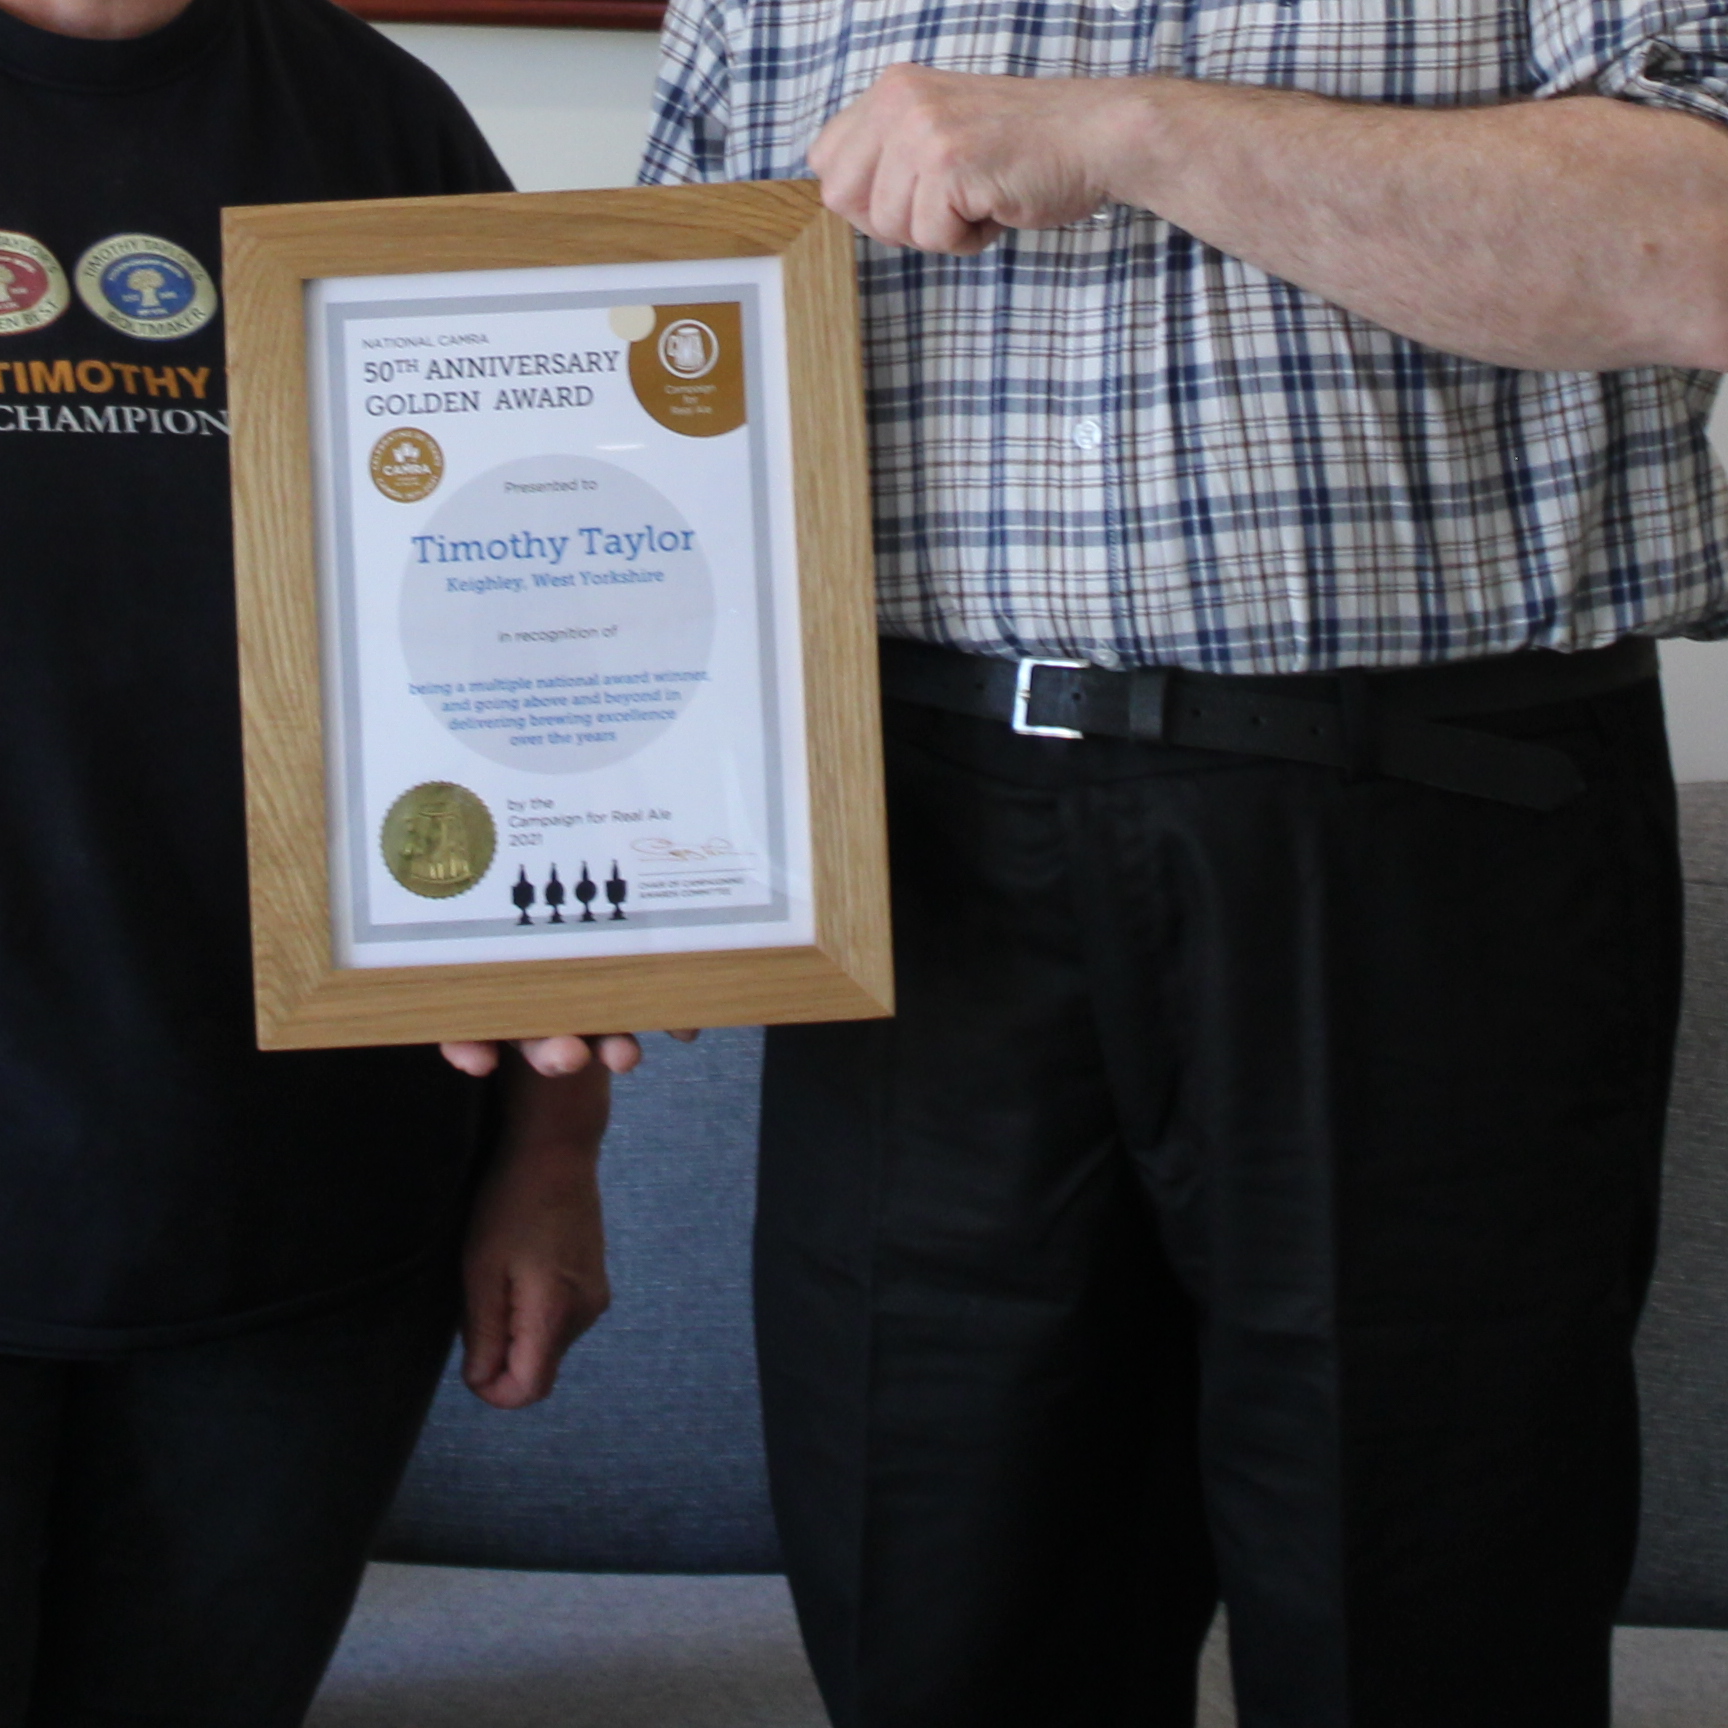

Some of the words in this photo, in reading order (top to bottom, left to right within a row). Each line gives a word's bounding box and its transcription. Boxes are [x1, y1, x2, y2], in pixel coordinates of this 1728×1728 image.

[84, 241, 136, 277] TIMOTHY
[362, 336, 434, 349] NATIONAL
[438, 333, 489, 346] CAMRA
[364, 358, 419, 384] 50TH
[424, 350, 620, 381] ANNIVERSARY
[365, 390, 480, 416] GOLDEN
[493, 385, 594, 411] AWARD
[504, 480, 577, 494] Presented
[582, 480, 597, 491] to
[411, 531, 569, 564] Timothy
[578, 524, 695, 560] Taylor
[532, 573, 576, 588] West
[579, 569, 664, 586] Yorkshire
[498, 632, 512, 642] in
[514, 628, 598, 643] recognition
[602, 625, 618, 638] of
[409, 683, 452, 696] being
[456, 684, 465, 693] a
[469, 678, 532, 693] multiple
[536, 674, 600, 689] national
[603, 672, 650, 685] award
[442, 700, 470, 712] and
[474, 699, 519, 713] going
[524, 696, 568, 708] above
[572, 694, 601, 705] and
[603, 691, 662, 705] beyond
[664, 690, 682, 701] in
[449, 717, 525, 730] delivering
[529, 714, 592, 726] brewing
[596, 709, 676, 722] excellence
[510, 735, 543, 746] over
[547, 733, 571, 744] the
[576, 732, 616, 745] years
[507, 799, 526, 812] by
[531, 798, 554, 809] the
[508, 814, 583, 828] Campaign
[586, 812, 607, 823] for
[611, 810, 643, 822] Real
[647, 809, 672, 821] Ale
